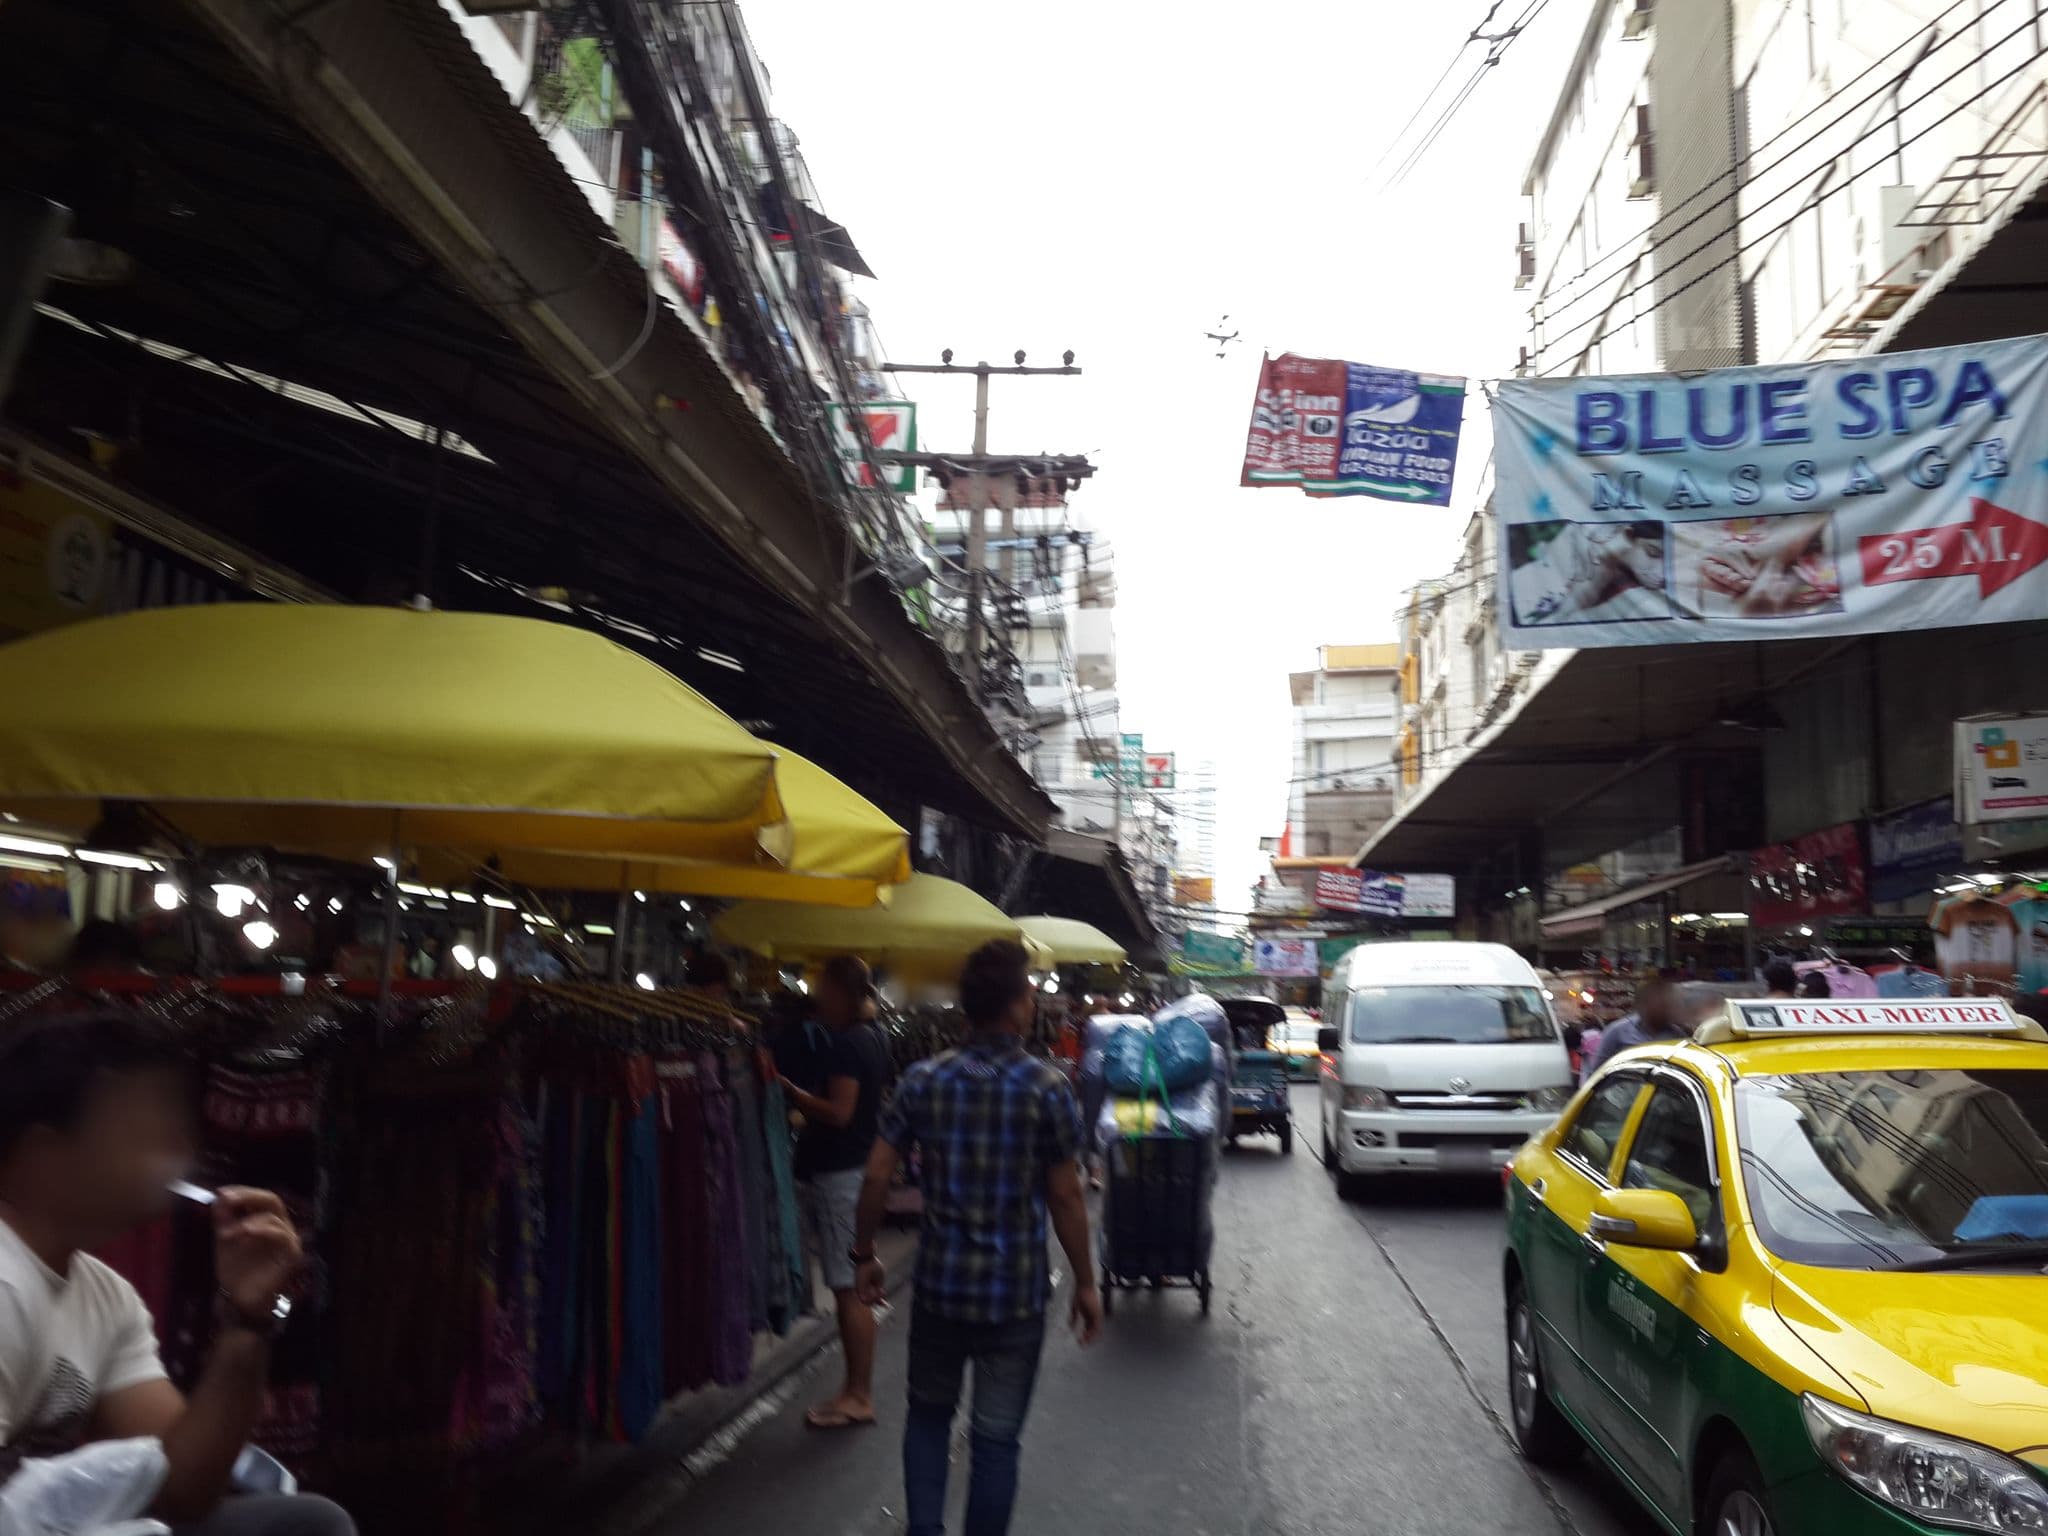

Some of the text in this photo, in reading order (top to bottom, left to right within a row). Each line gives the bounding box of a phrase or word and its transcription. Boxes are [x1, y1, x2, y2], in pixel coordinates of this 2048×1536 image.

[1577, 361, 2010, 456] BLUE SPA
[1591, 437, 2010, 511] MASSAGE
[1878, 525, 2023, 575] 25 M.
[1783, 1005, 2006, 1026] TAXI-METER
